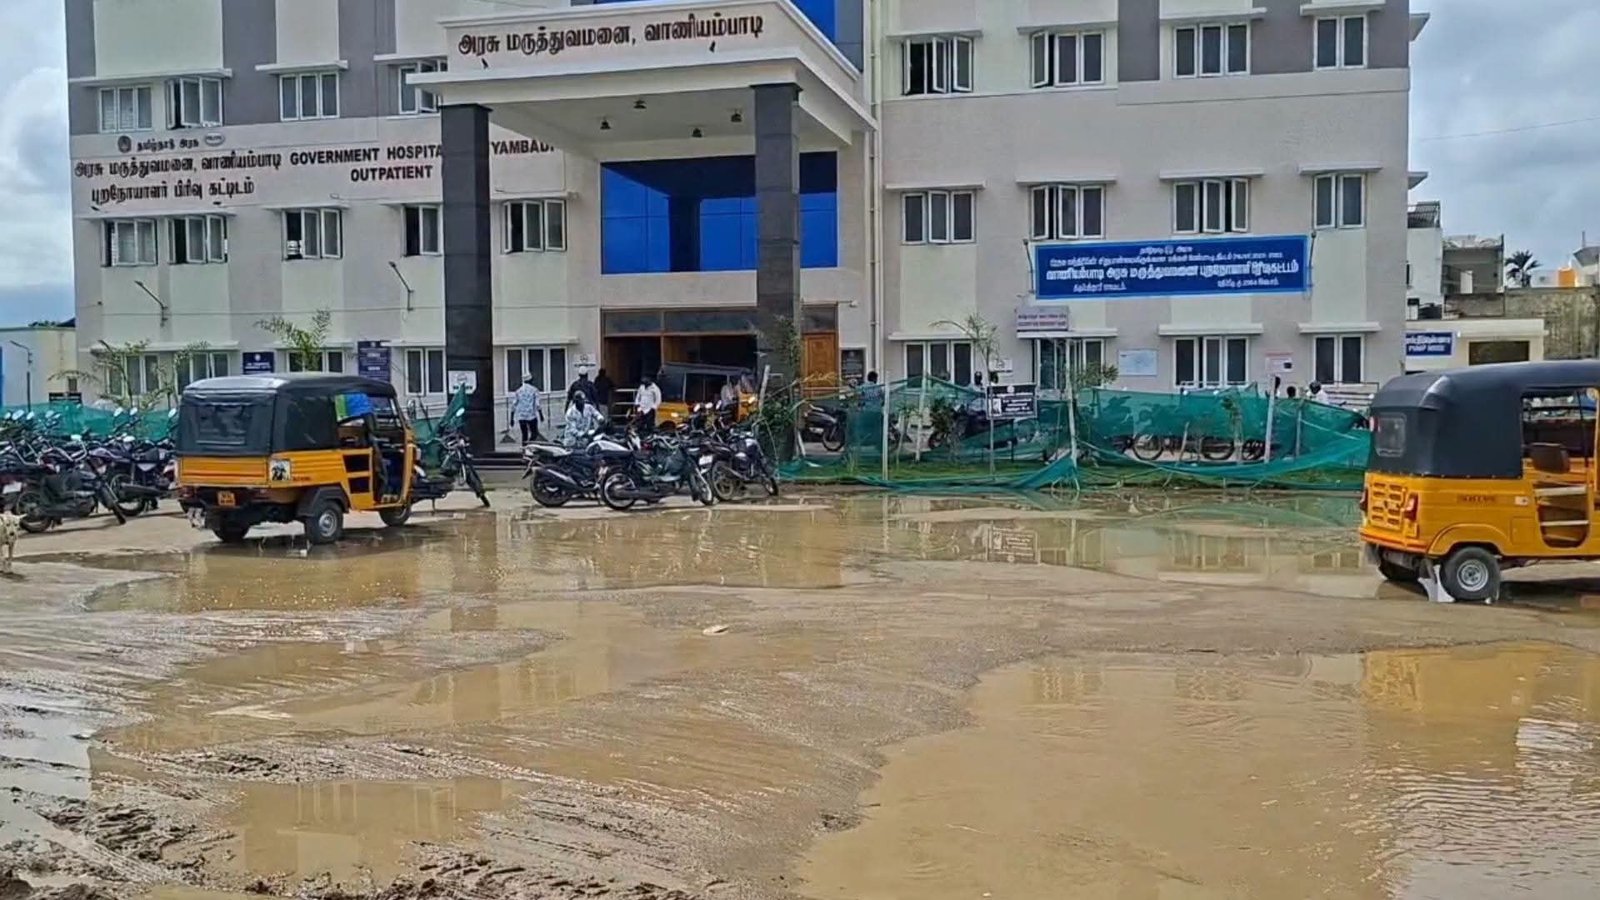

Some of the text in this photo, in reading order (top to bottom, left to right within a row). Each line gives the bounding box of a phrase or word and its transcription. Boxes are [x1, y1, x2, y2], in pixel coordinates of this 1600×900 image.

[458, 12, 764, 56] அரசு மருத்துவமனை, வாணியம்பாடி
[74, 150, 282, 179] அரசு மருத்துவமனை, வாணியம்பாடி
[290, 147, 380, 166] GOVERNMENT
[387, 144, 442, 161] HOSPITA
[350, 164, 433, 182] OUTPATIENT
[91, 176, 255, 205] புறநோயாளர் பிரிவு கட்டிடம்
